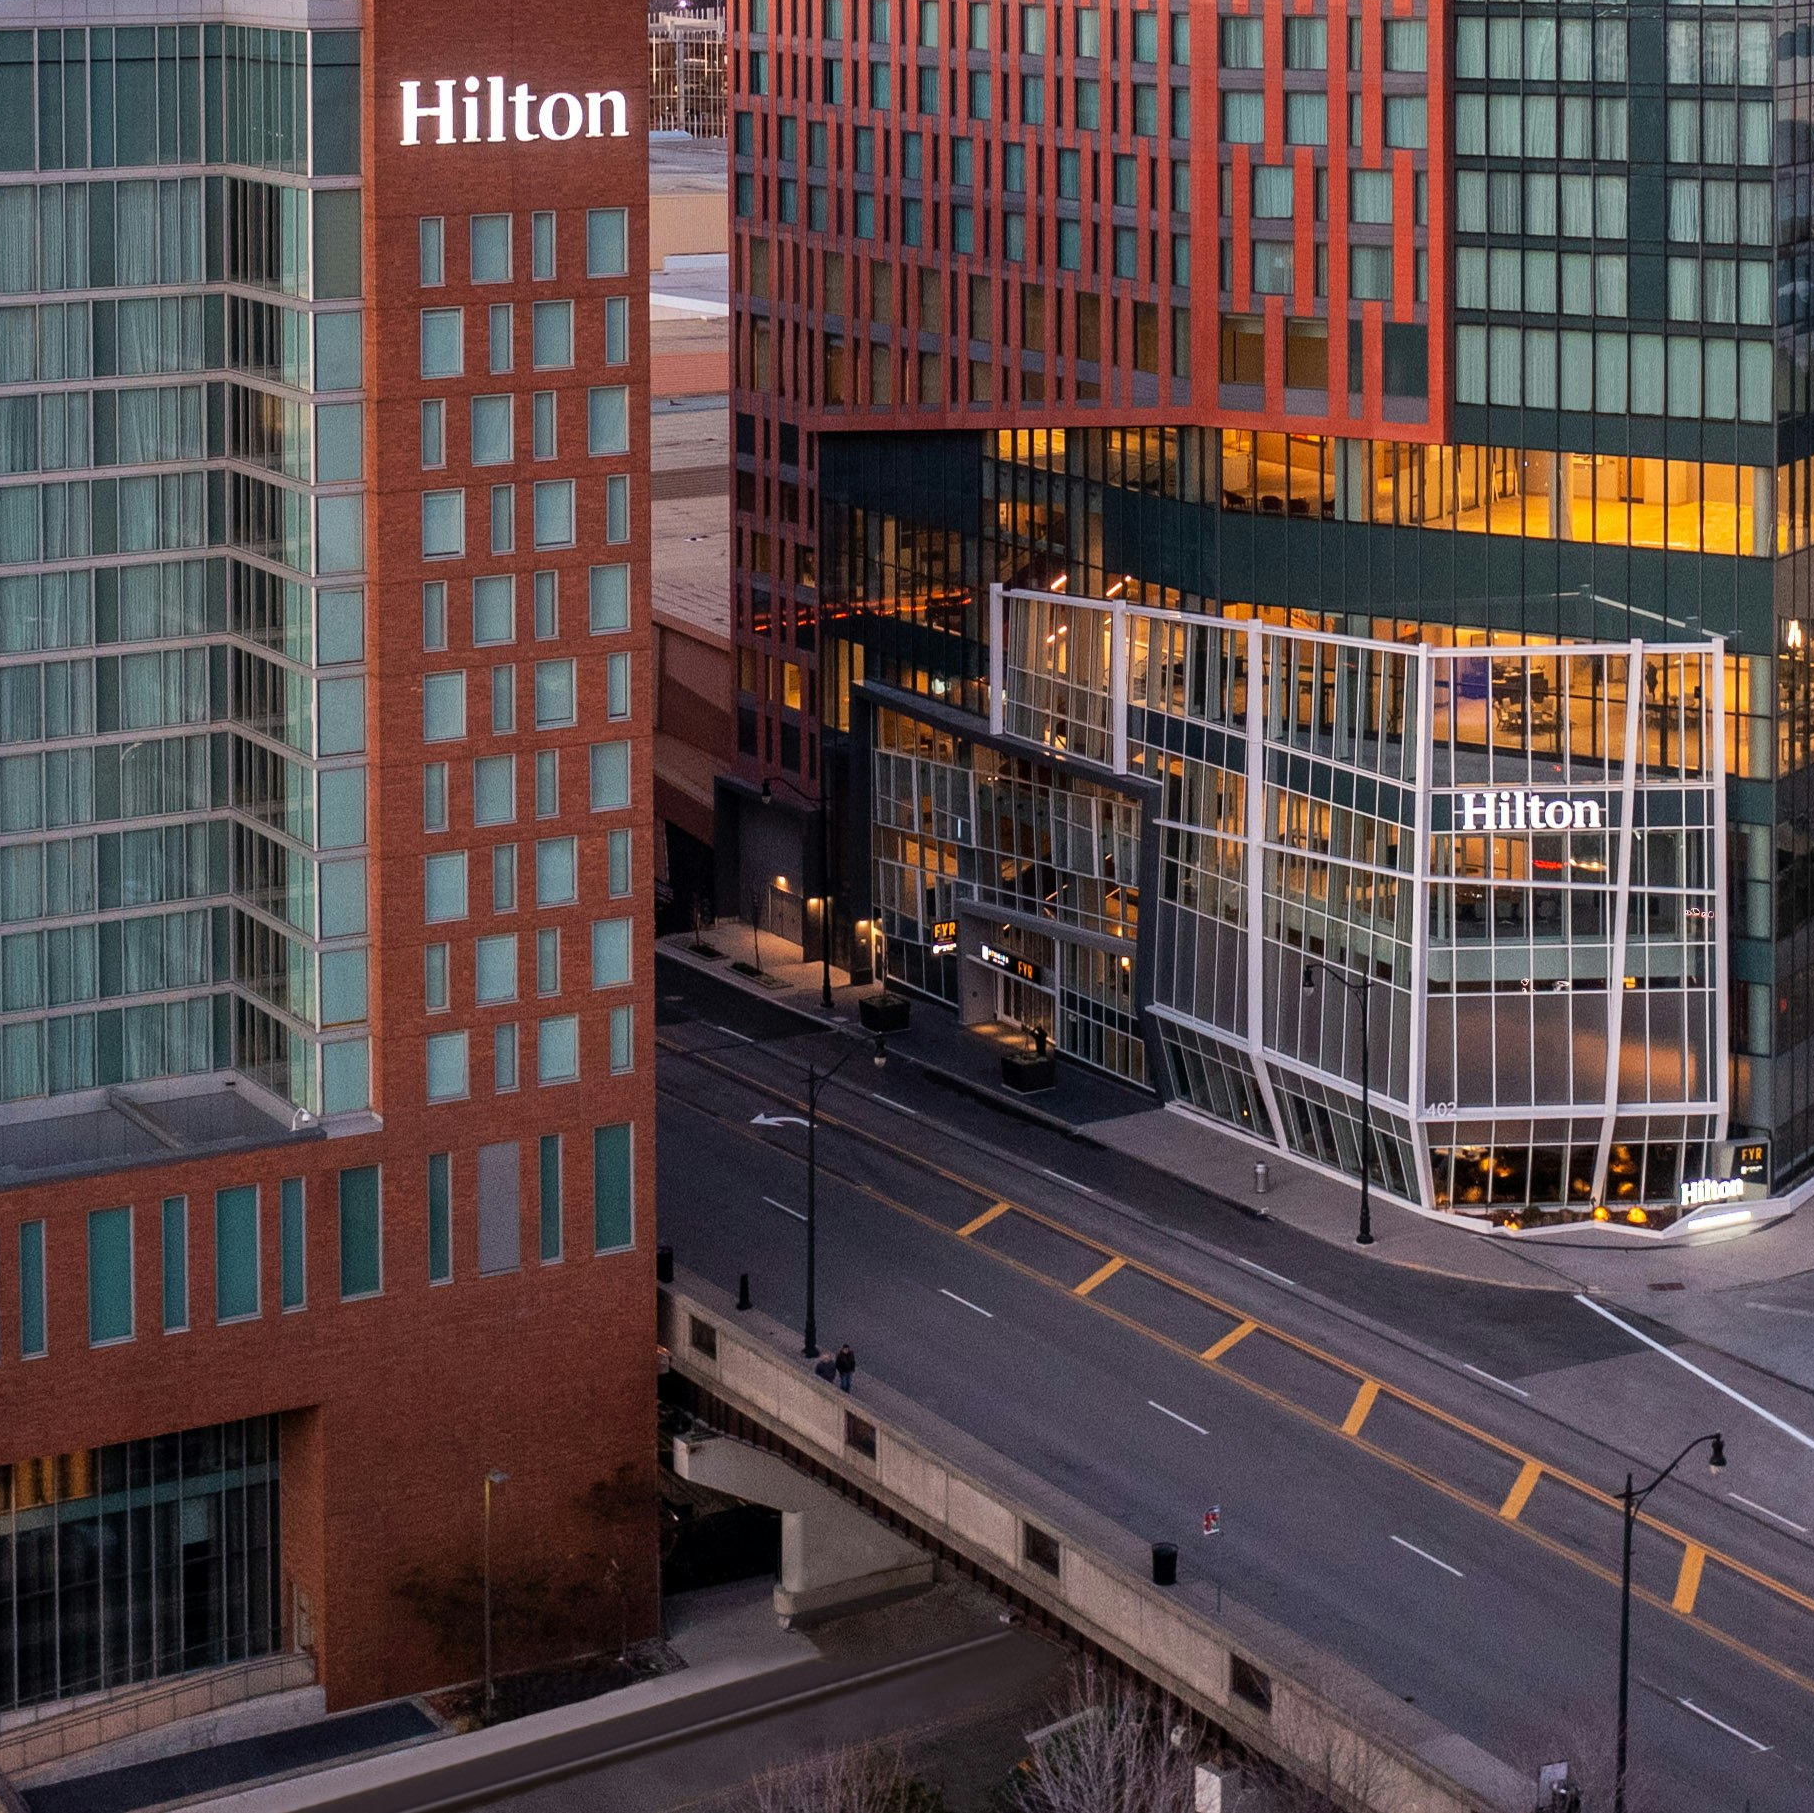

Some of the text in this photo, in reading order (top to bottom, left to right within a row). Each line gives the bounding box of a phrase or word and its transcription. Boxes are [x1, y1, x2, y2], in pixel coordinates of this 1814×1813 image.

[399, 75, 630, 146] Hilton
[1462, 791, 1602, 831] Hilton
[934, 921, 956, 938] FYR
[1426, 1102, 1457, 1117] 402
[1741, 1147, 1763, 1162] FYR
[1680, 1177, 1744, 1206] Hilton
